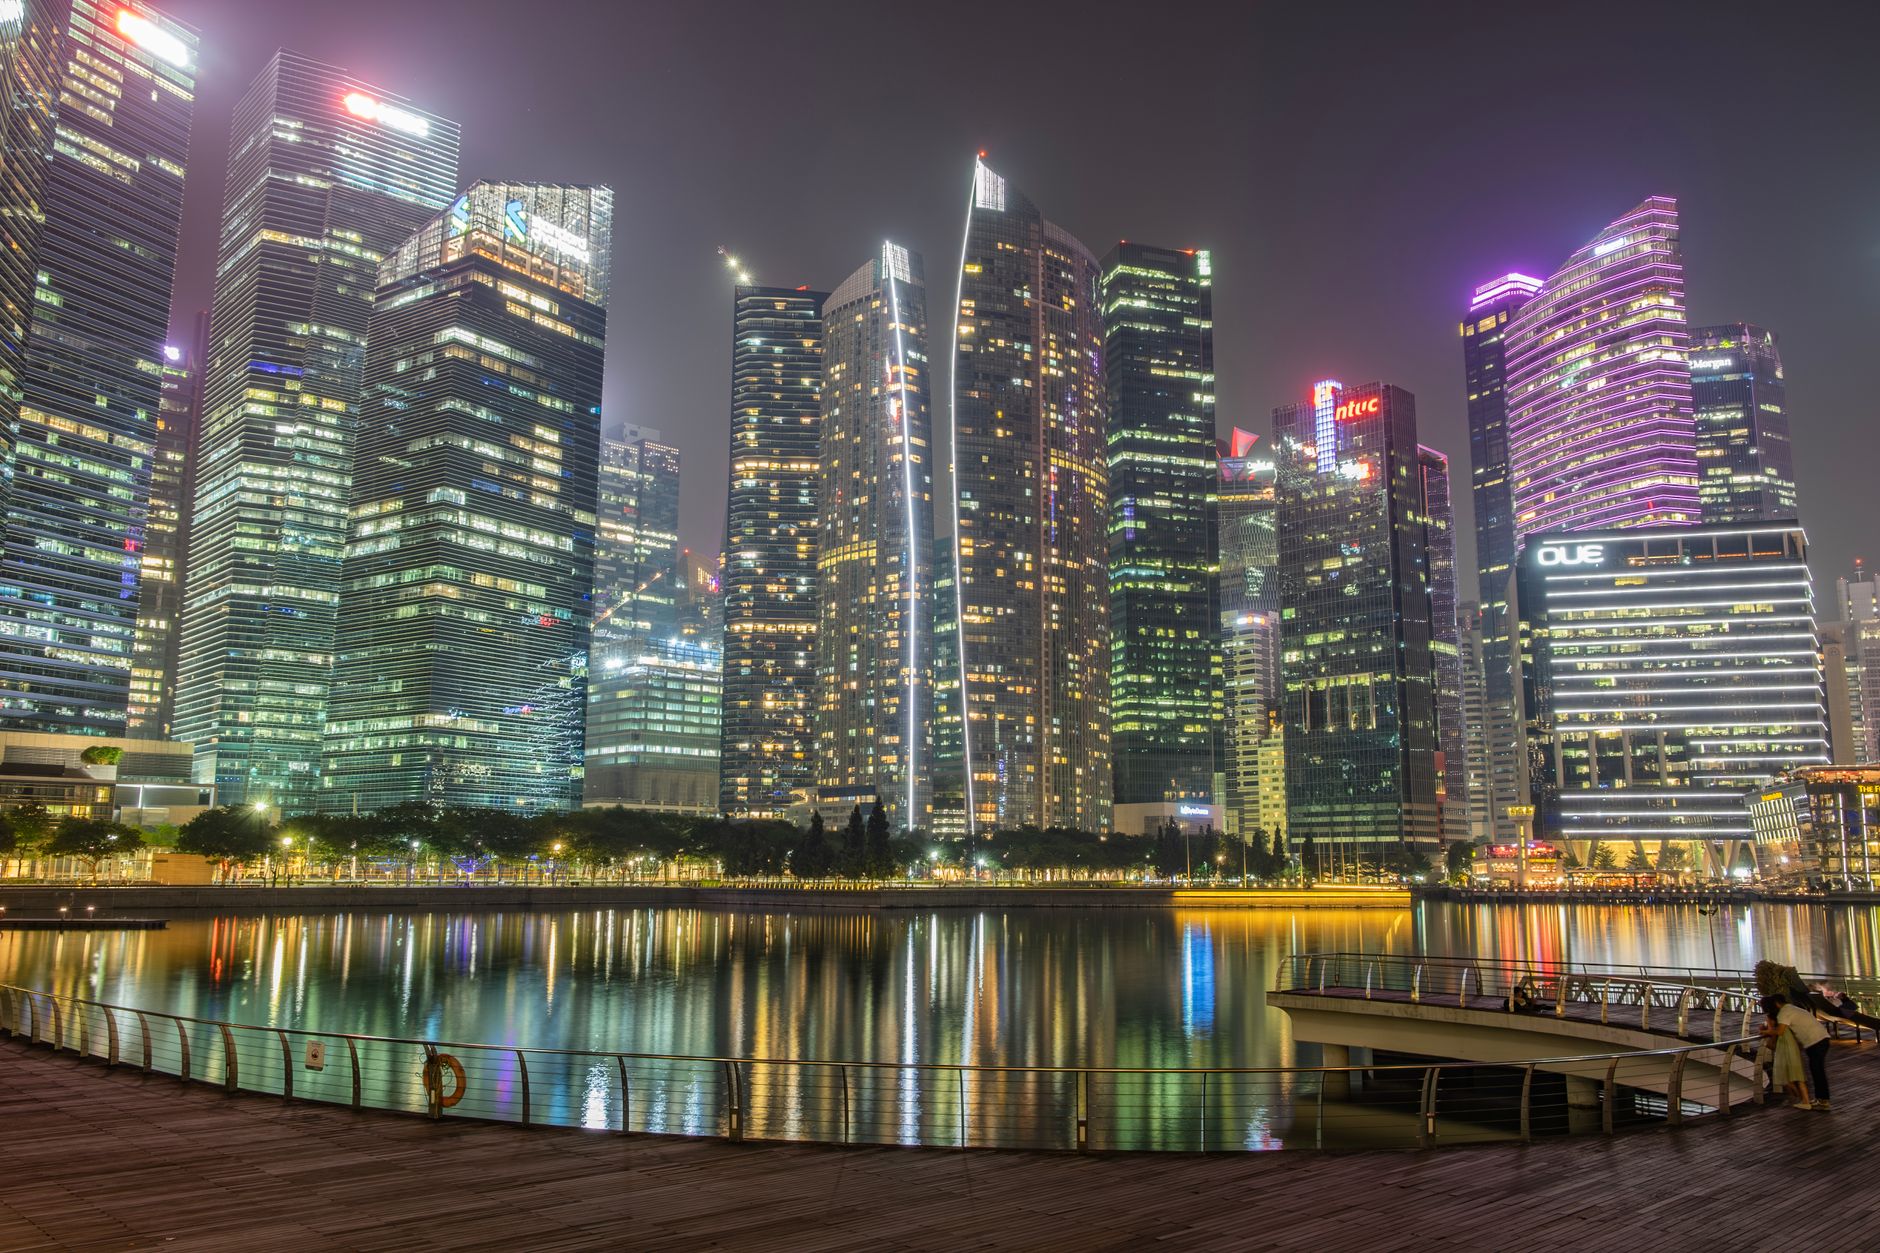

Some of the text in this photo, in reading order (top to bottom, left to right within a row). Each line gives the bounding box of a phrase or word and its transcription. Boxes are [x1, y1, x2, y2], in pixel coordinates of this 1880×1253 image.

[1335, 398, 1378, 421] ntuc
[1537, 544, 1605, 566] OUE
[1858, 785, 1873, 793] THE
